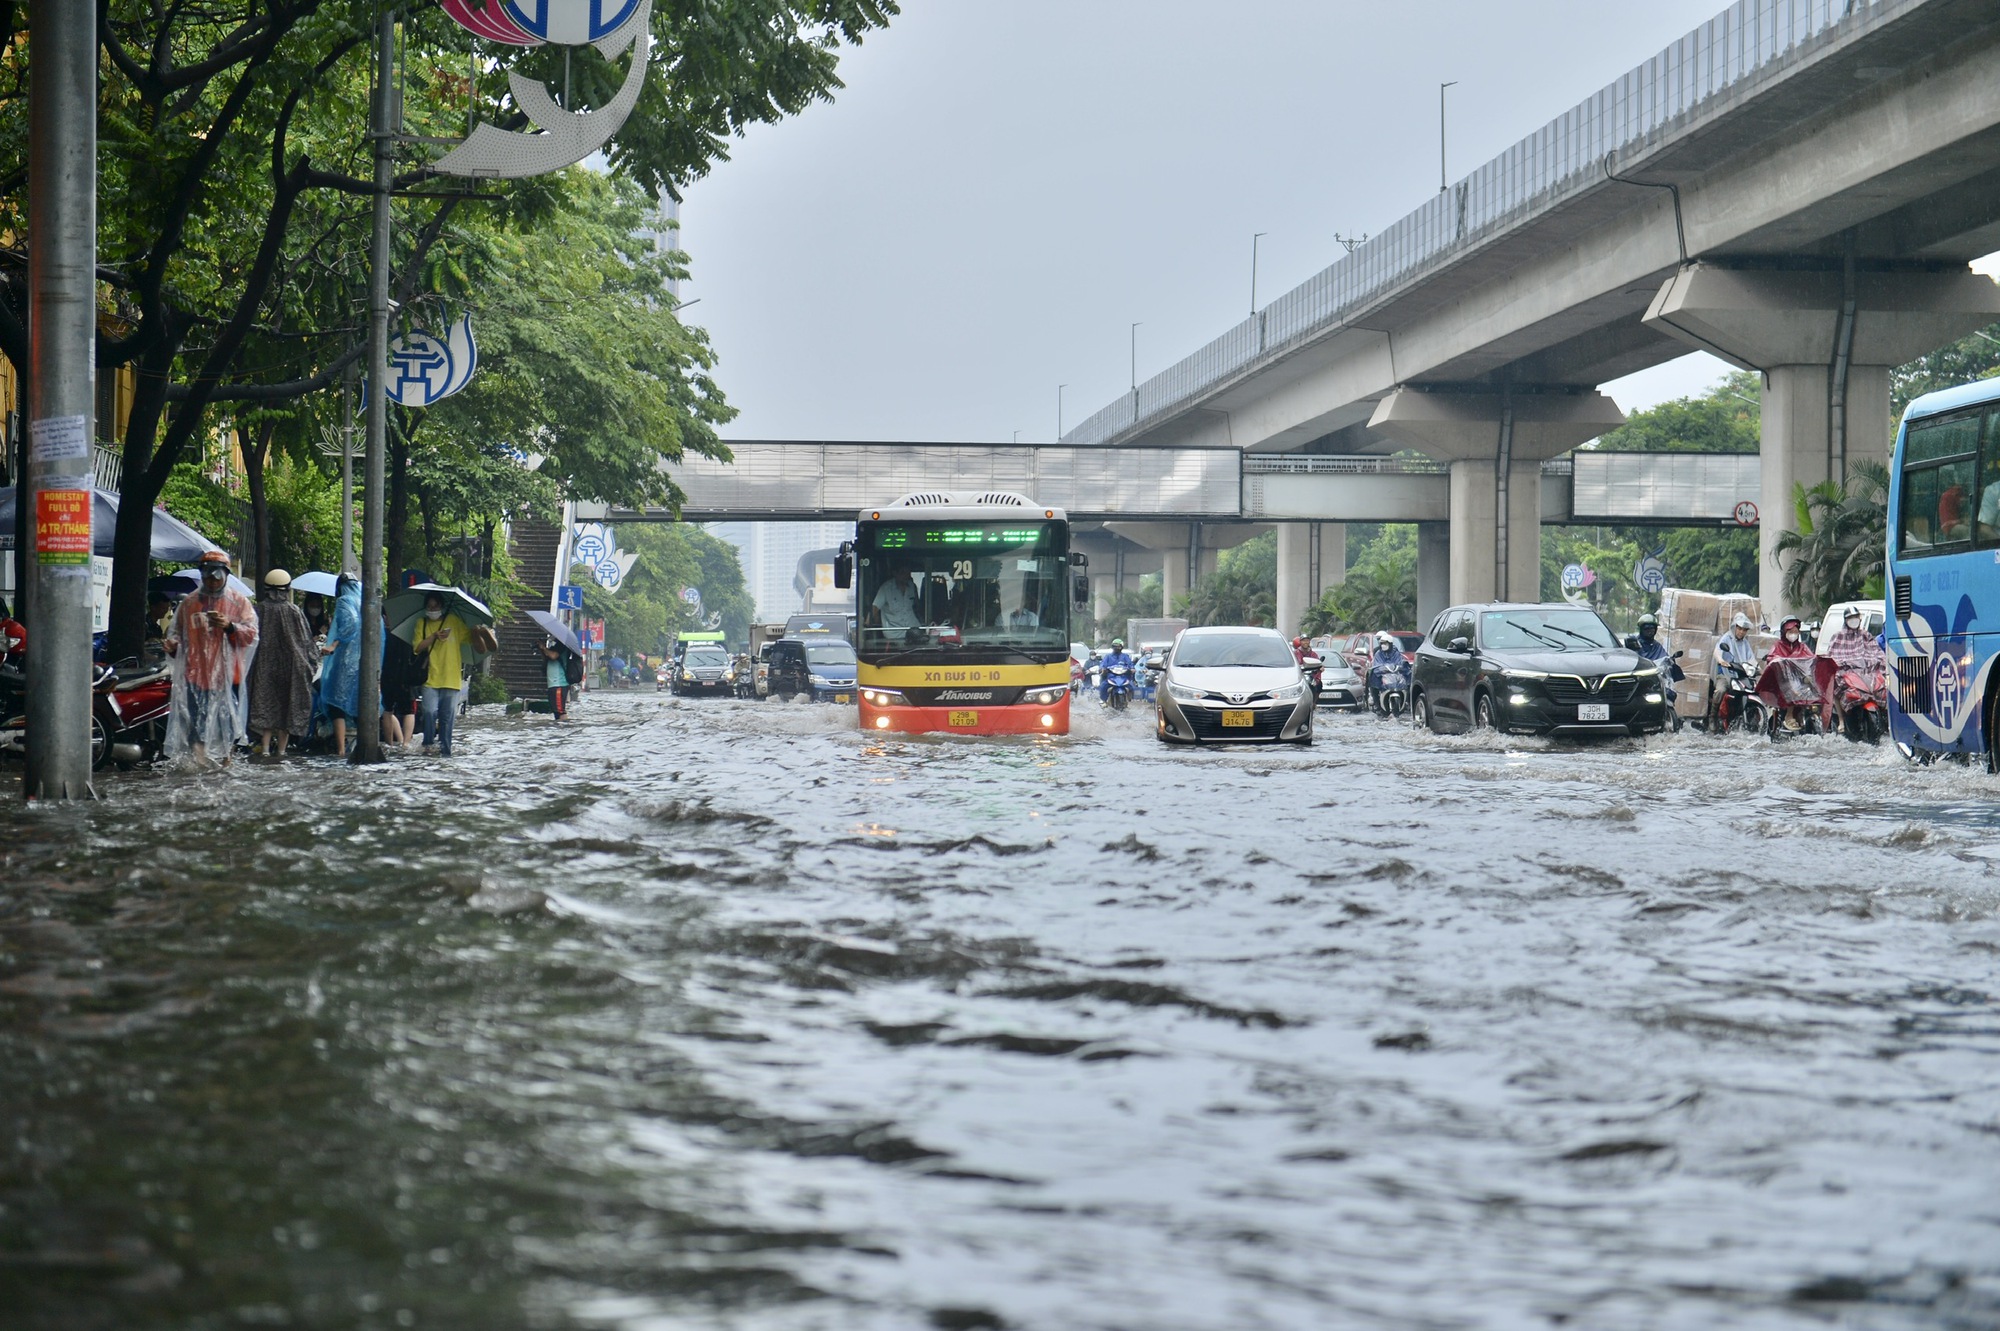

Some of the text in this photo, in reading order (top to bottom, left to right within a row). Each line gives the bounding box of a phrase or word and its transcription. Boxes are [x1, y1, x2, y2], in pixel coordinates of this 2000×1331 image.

[44, 493, 85, 501] HOMESTAY
[953, 560, 972, 579] 29
[945, 672, 965, 680] BUS
[970, 671, 980, 680] 10
[989, 671, 1000, 680] 10
[934, 690, 992, 700] HANOIBUS
